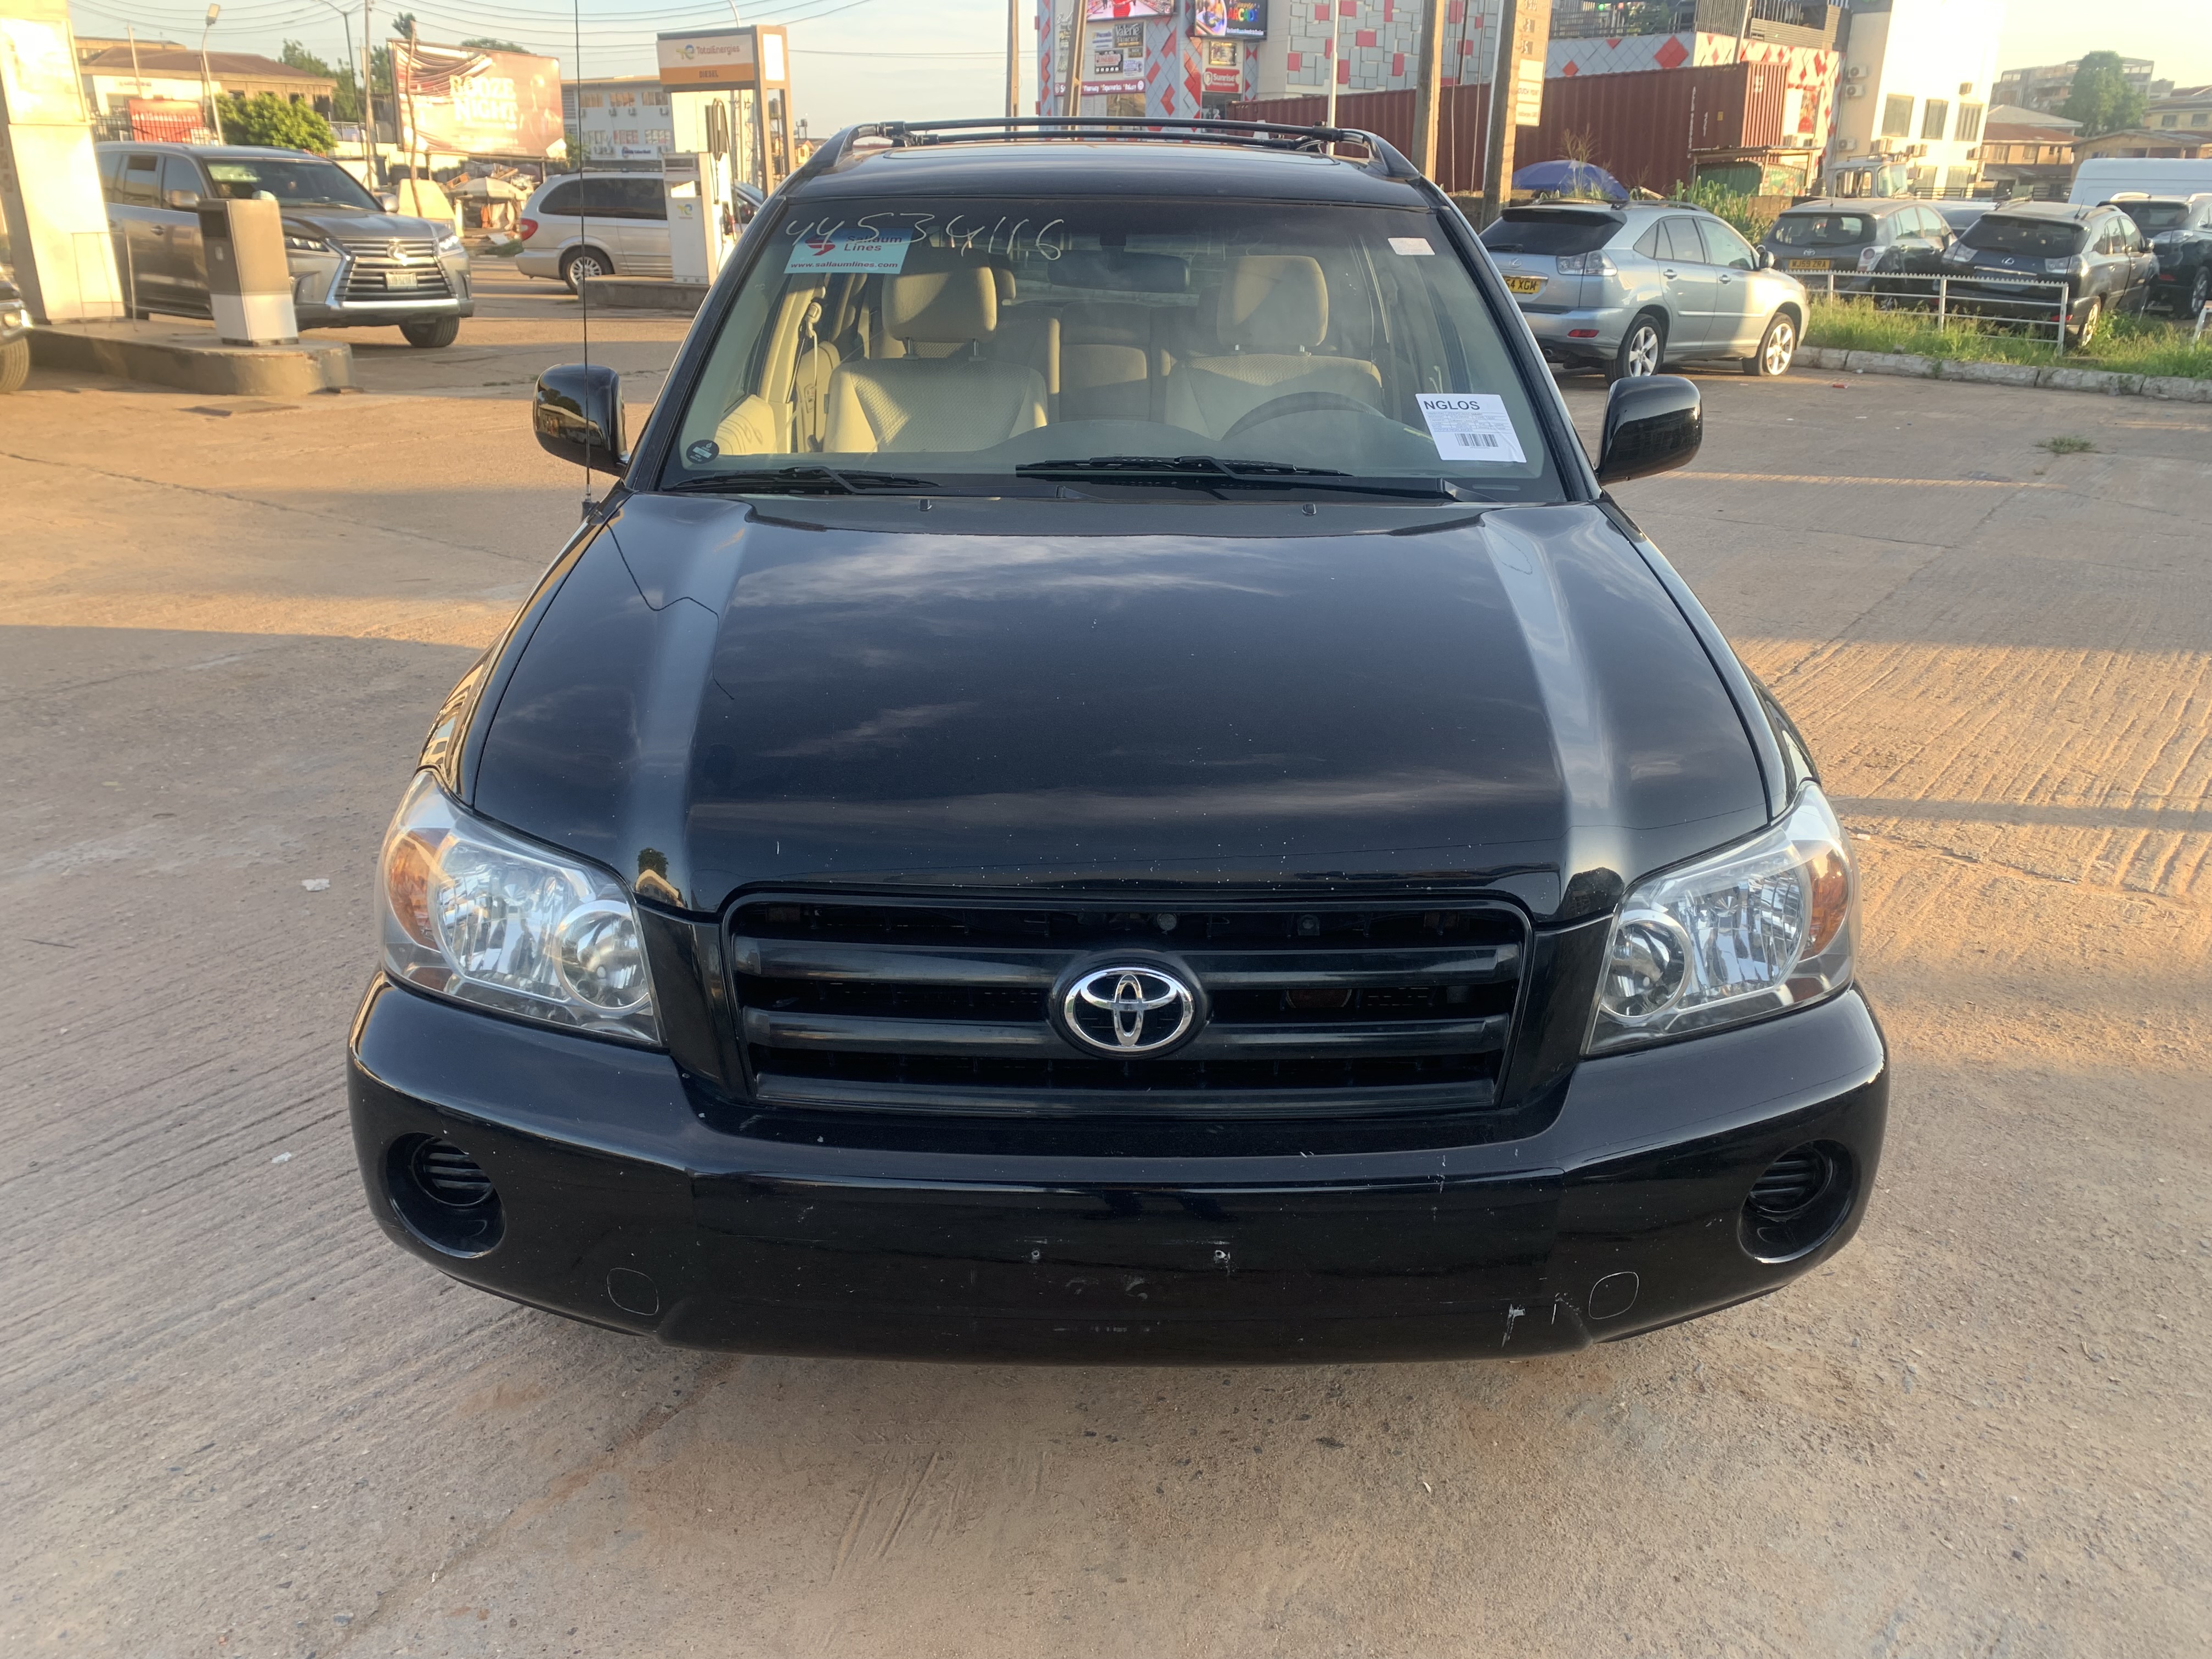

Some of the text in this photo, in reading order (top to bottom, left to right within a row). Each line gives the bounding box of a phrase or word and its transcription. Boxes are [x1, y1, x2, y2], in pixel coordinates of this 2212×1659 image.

[1228, 8, 1259, 22] ARCADE
[1116, 23, 1140, 36] Valerie
[696, 44, 740, 55] TotalEnergies
[449, 75, 516, 99] BOOZE
[452, 98, 517, 122] NIGHT
[1423, 400, 1481, 410] NGLOS
